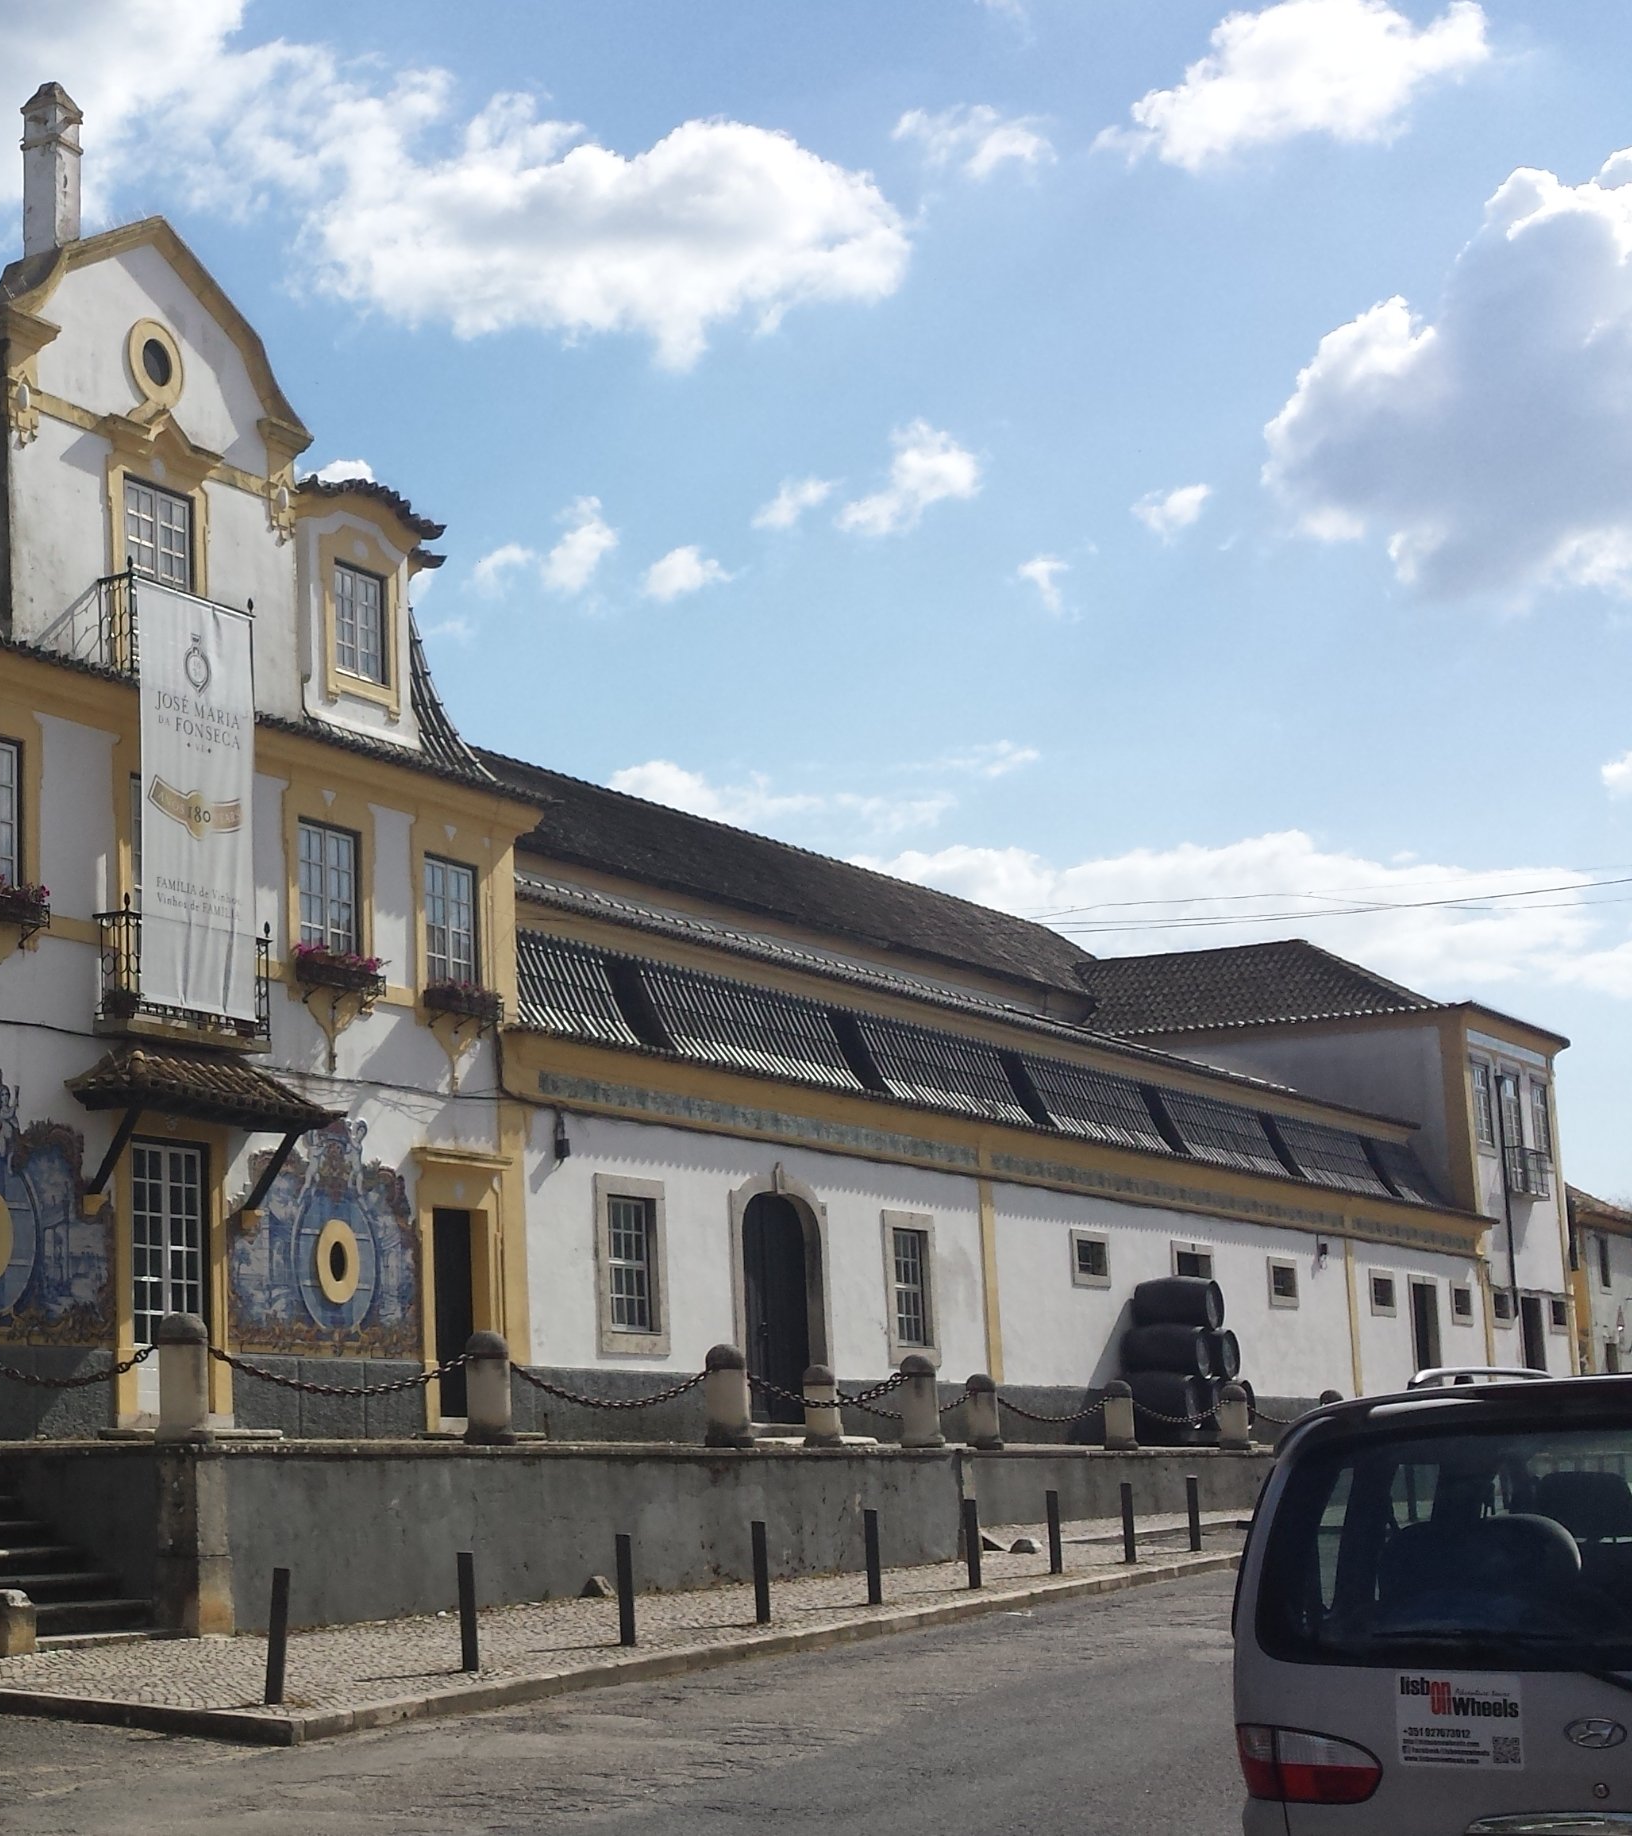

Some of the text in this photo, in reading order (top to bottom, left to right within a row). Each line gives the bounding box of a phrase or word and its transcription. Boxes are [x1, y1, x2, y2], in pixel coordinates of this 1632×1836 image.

[154, 690, 240, 730] JOSÉ MARIA
[175, 716, 240, 750] FONSECA
[156, 891, 187, 909] Vinhos
[199, 886, 209, 899] de
[1403, 1727, 1423, 1737] +351
